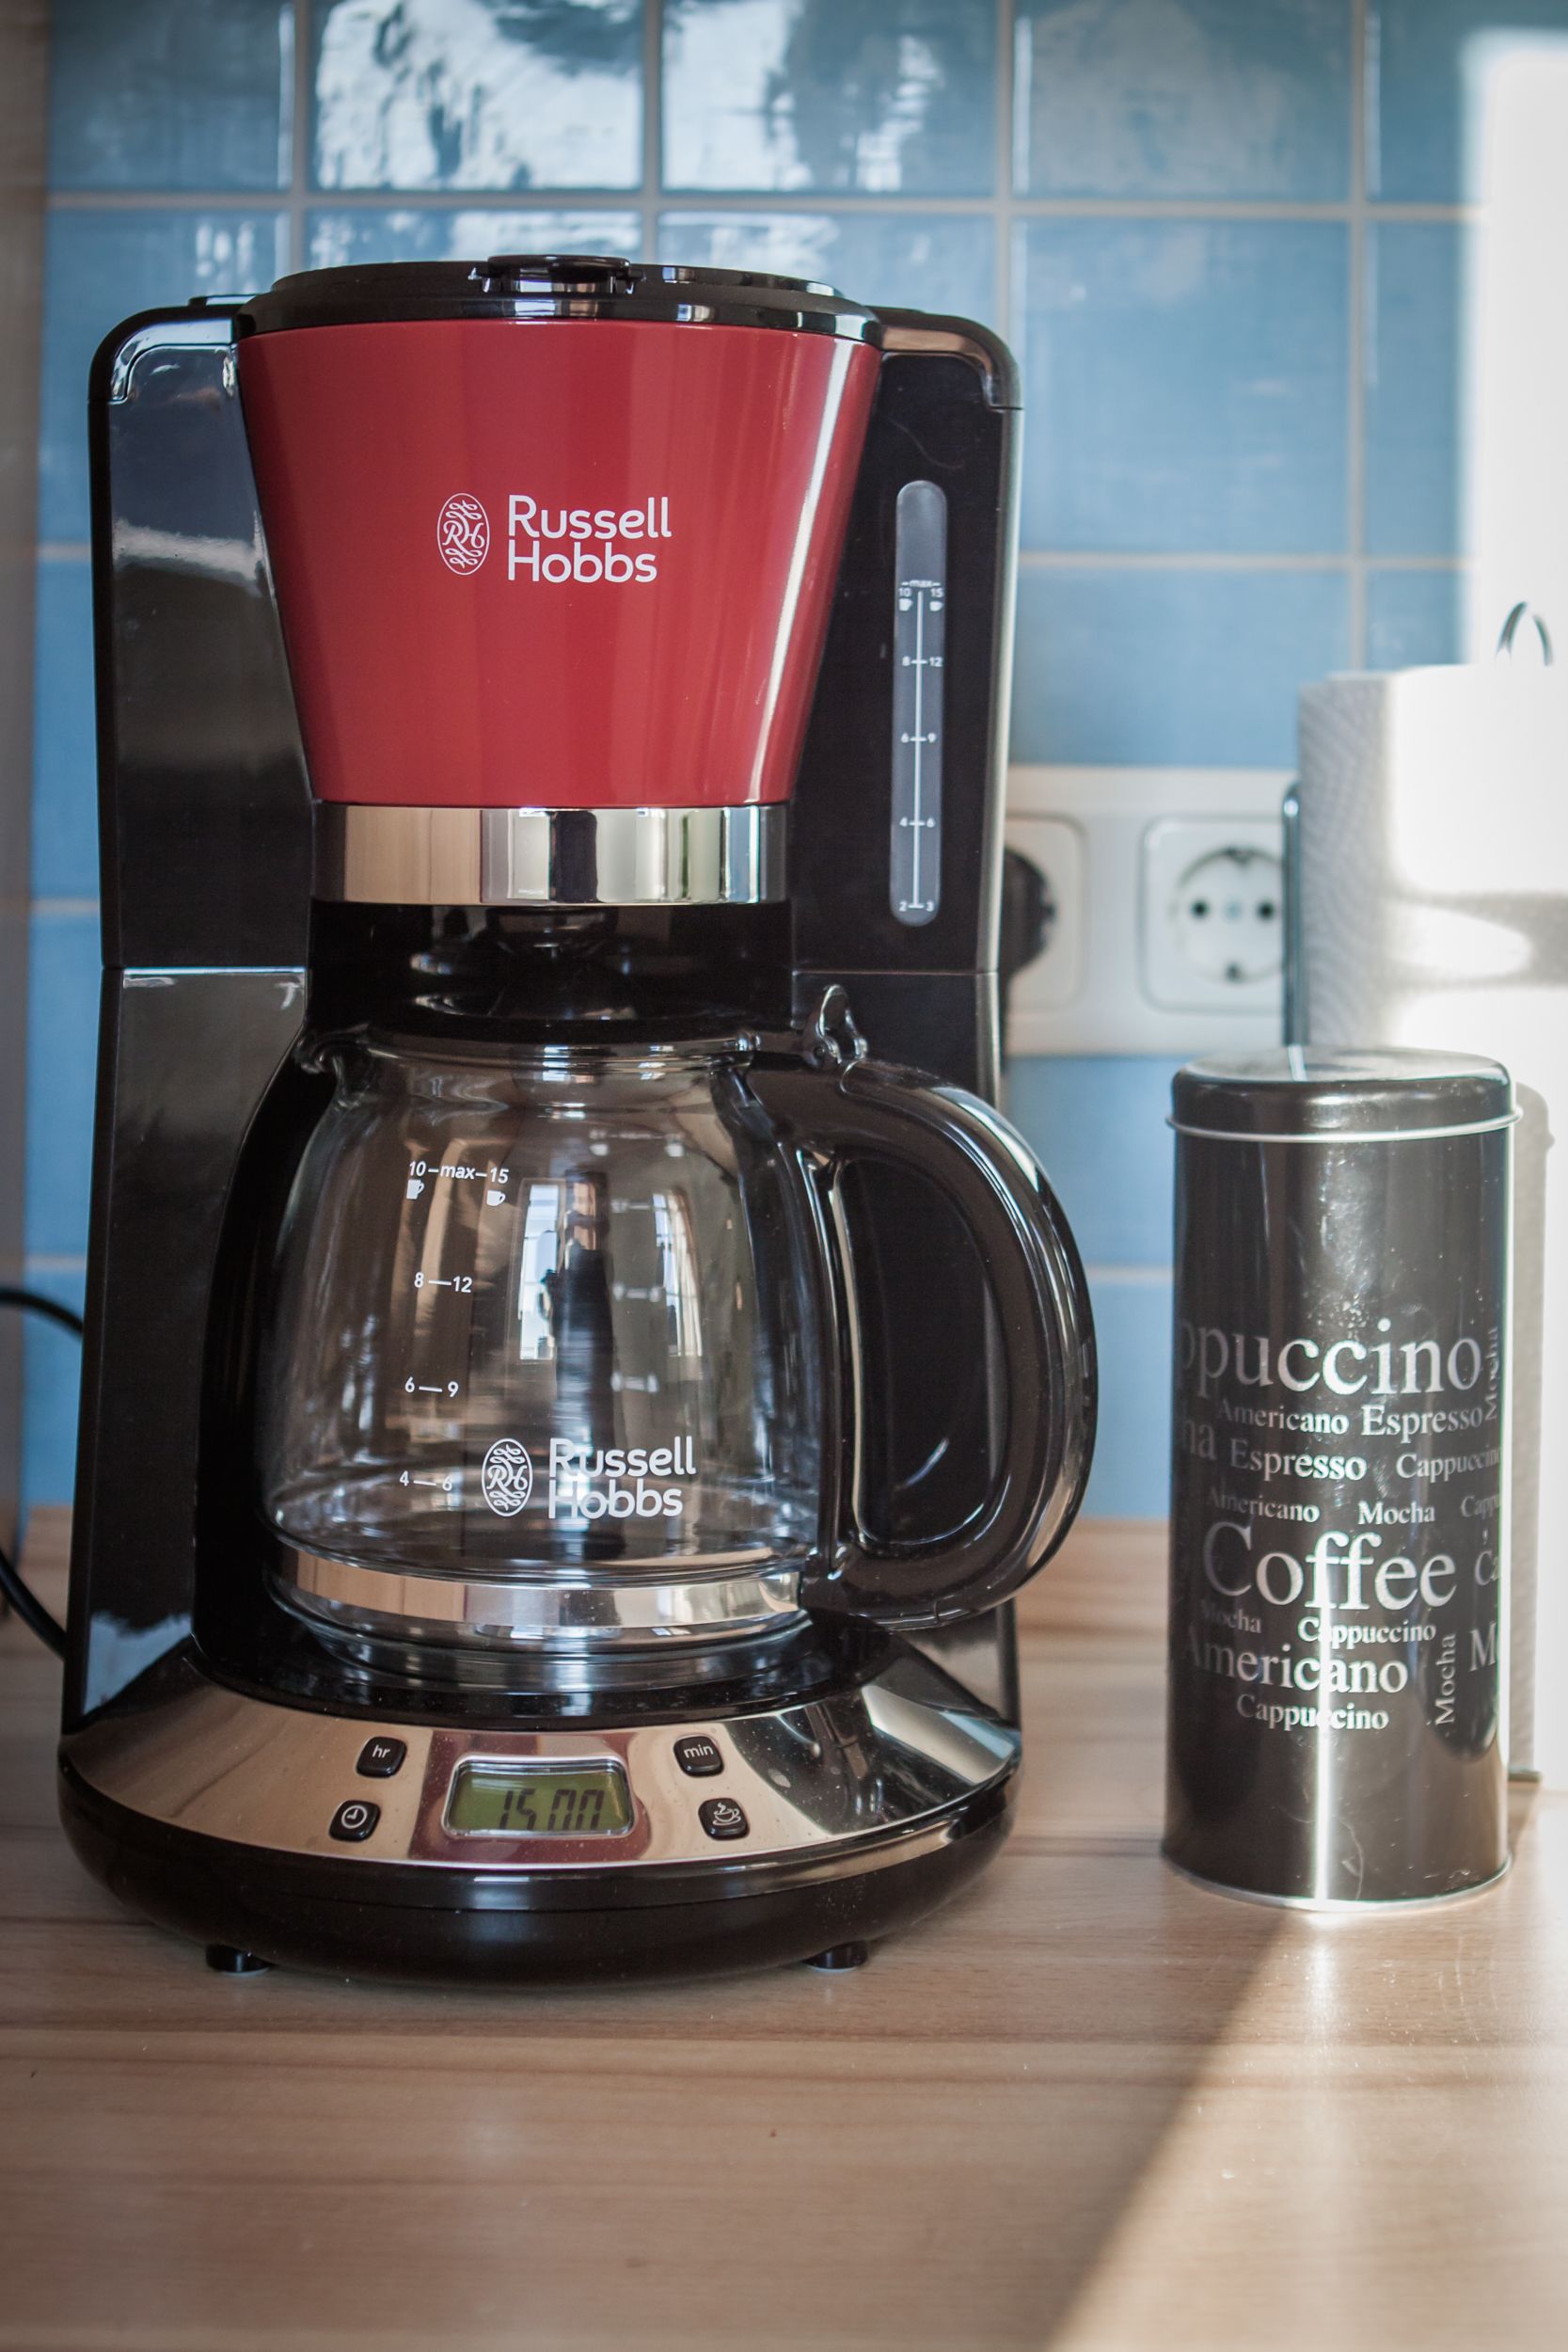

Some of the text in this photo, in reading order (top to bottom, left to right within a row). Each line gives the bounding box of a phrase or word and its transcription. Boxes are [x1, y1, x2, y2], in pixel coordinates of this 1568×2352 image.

[508, 494, 673, 540] Russell
[508, 539, 657, 583] Hobbs
[898, 587, 944, 598] 10 15
[929, 657, 943, 668] 12
[899, 817, 909, 828] 4
[898, 900, 935, 913] 2 3
[1218, 1397, 1483, 1444] Americano Espresso
[548, 1436, 697, 1478] Russell
[1229, 1438, 1368, 1482] Espresso
[548, 1478, 684, 1520] Hobbs
[1208, 1486, 1321, 1523] Americano
[1358, 1500, 1435, 1525] Mocha
[1203, 1521, 1457, 1611] Coffee
[1435, 1633, 1456, 1726] Mocha
[372, 1744, 391, 1758] hr
[683, 1743, 714, 1758] min
